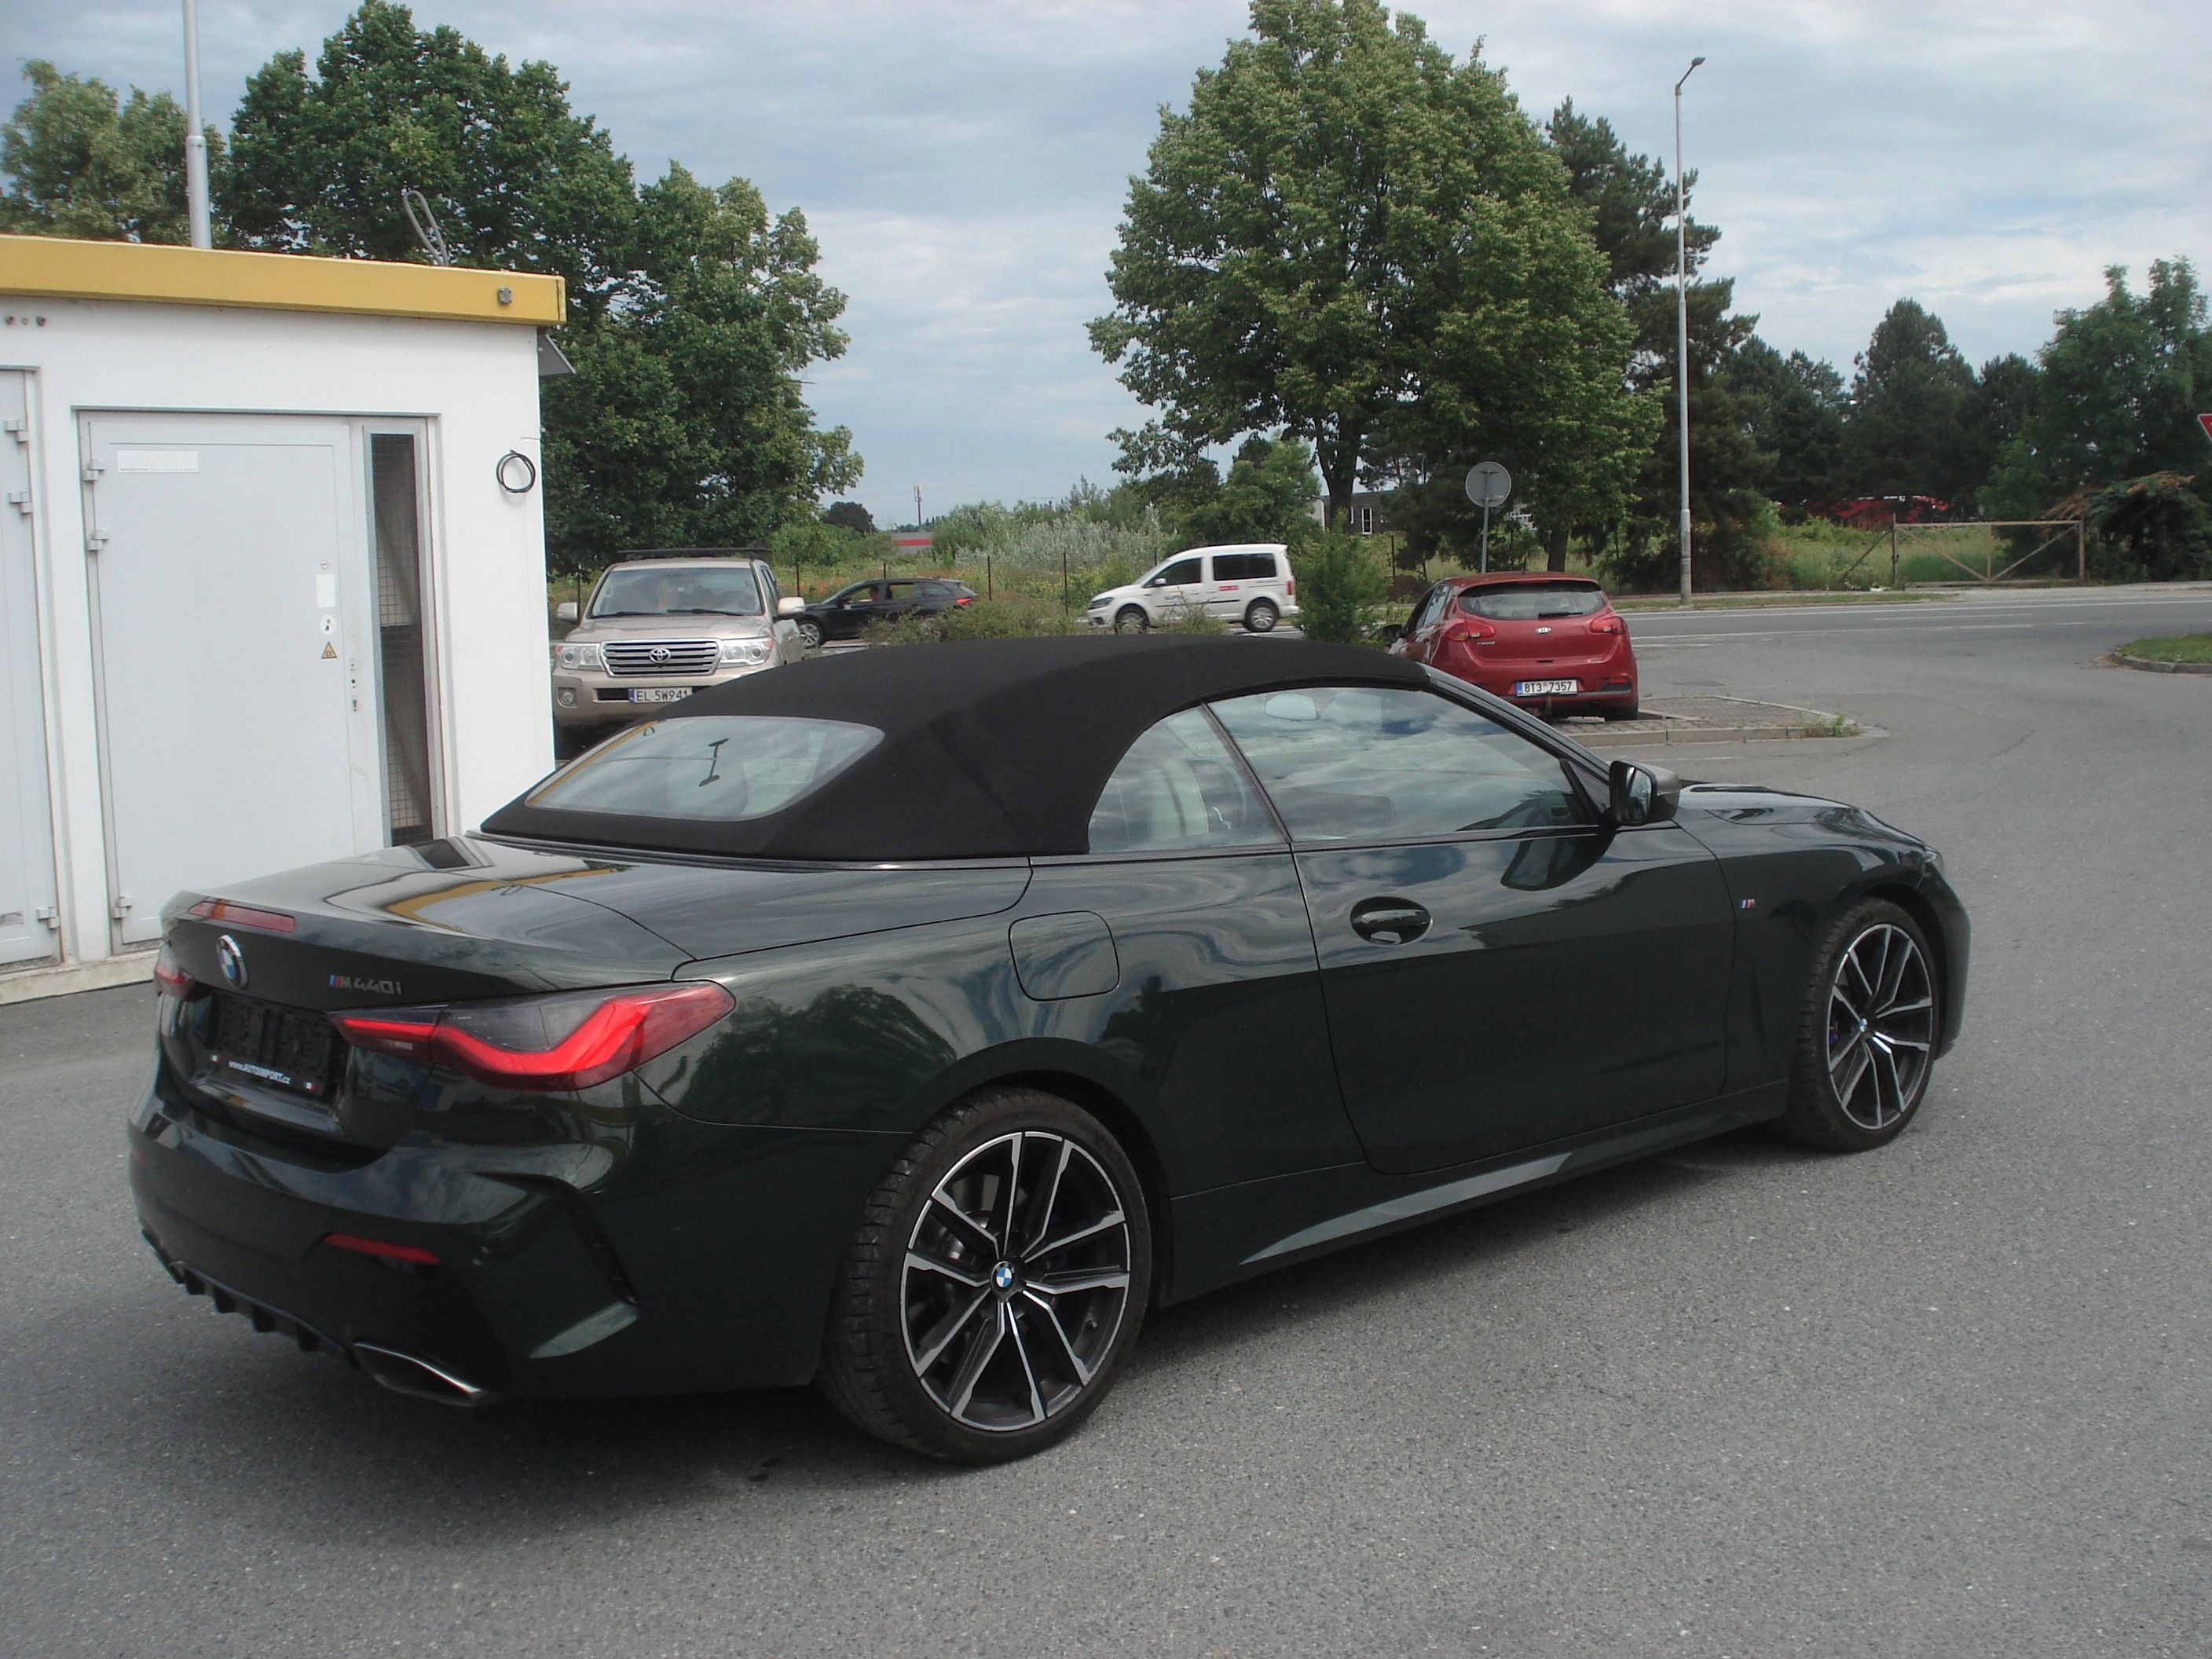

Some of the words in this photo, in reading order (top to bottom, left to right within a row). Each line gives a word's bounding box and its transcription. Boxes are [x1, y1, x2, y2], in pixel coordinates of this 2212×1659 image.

[1524, 683, 1542, 693] 8T3
[1550, 681, 1572, 691] 7357
[636, 691, 650, 701] EL
